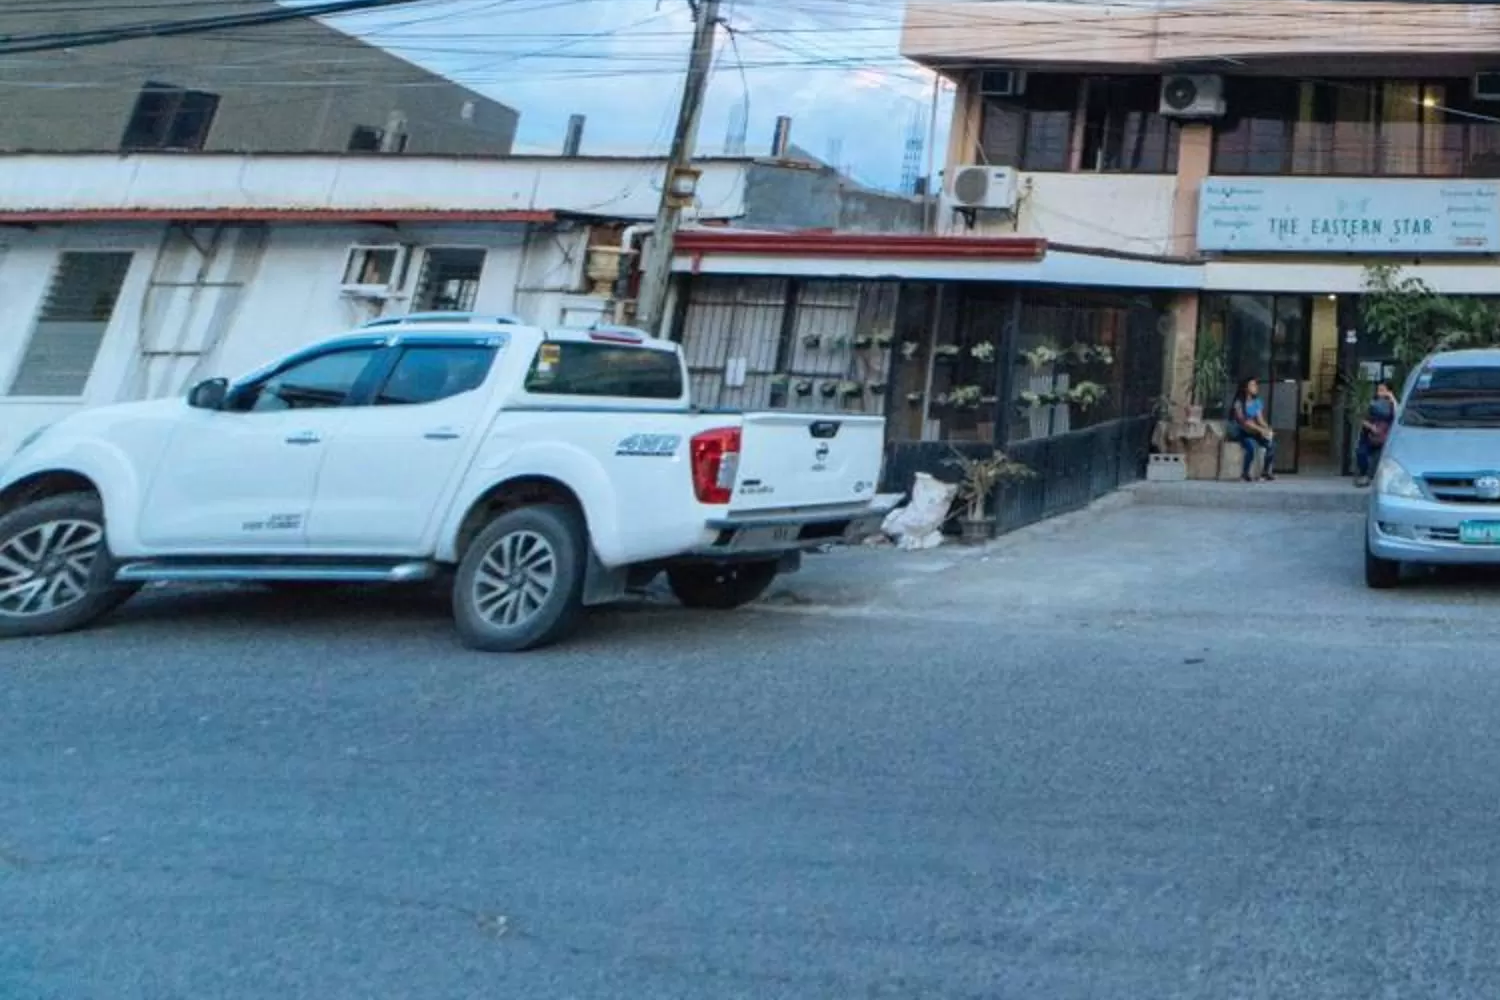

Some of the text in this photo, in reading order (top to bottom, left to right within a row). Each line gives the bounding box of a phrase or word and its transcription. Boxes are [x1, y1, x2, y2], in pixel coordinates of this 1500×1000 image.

[1268, 218, 1299, 234] THE
[1311, 218, 1382, 235] EASTERN
[1393, 218, 1433, 235] STAR
